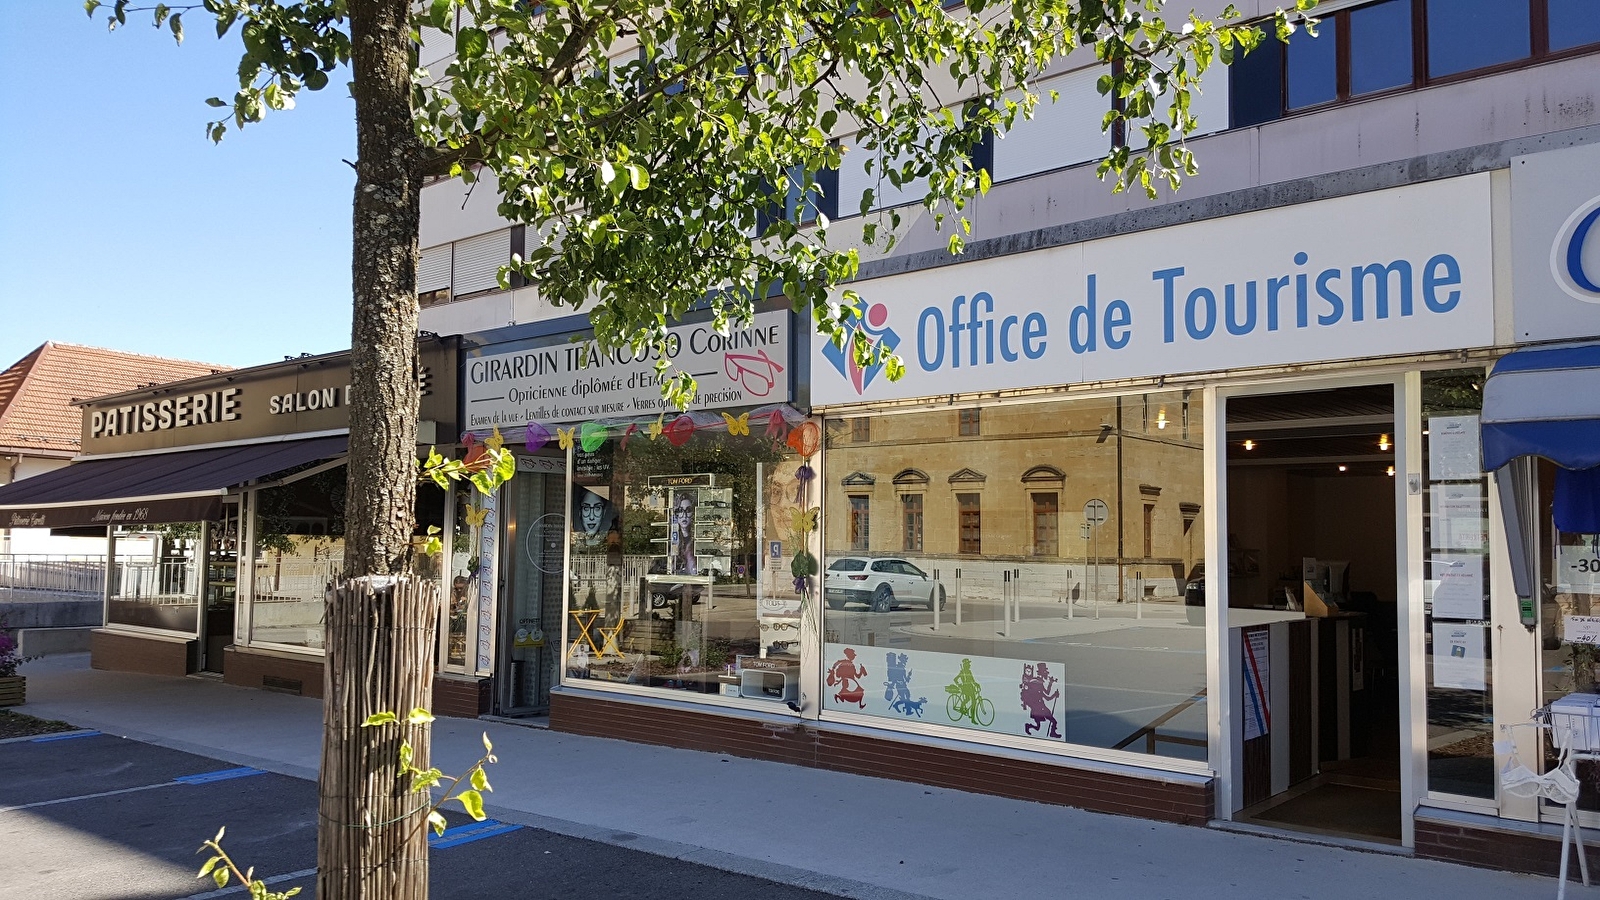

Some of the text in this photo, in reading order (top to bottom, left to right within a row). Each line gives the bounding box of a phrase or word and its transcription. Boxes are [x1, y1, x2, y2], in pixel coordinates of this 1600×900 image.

[917, 251, 1461, 373] Office de Tourisme
[471, 350, 558, 385] GIRARDIN
[269, 387, 335, 415] SALON
[571, 375, 623, 399] diplômée
[91, 387, 237, 439] PATISSERIE
[492, 410, 499, 424] de
[525, 405, 550, 421] Lentilles
[551, 404, 559, 419] de
[588, 404, 600, 415] sur
[632, 396, 656, 410] Verres
[692, 389, 702, 405] de
[133, 507, 149, 521] 1968
